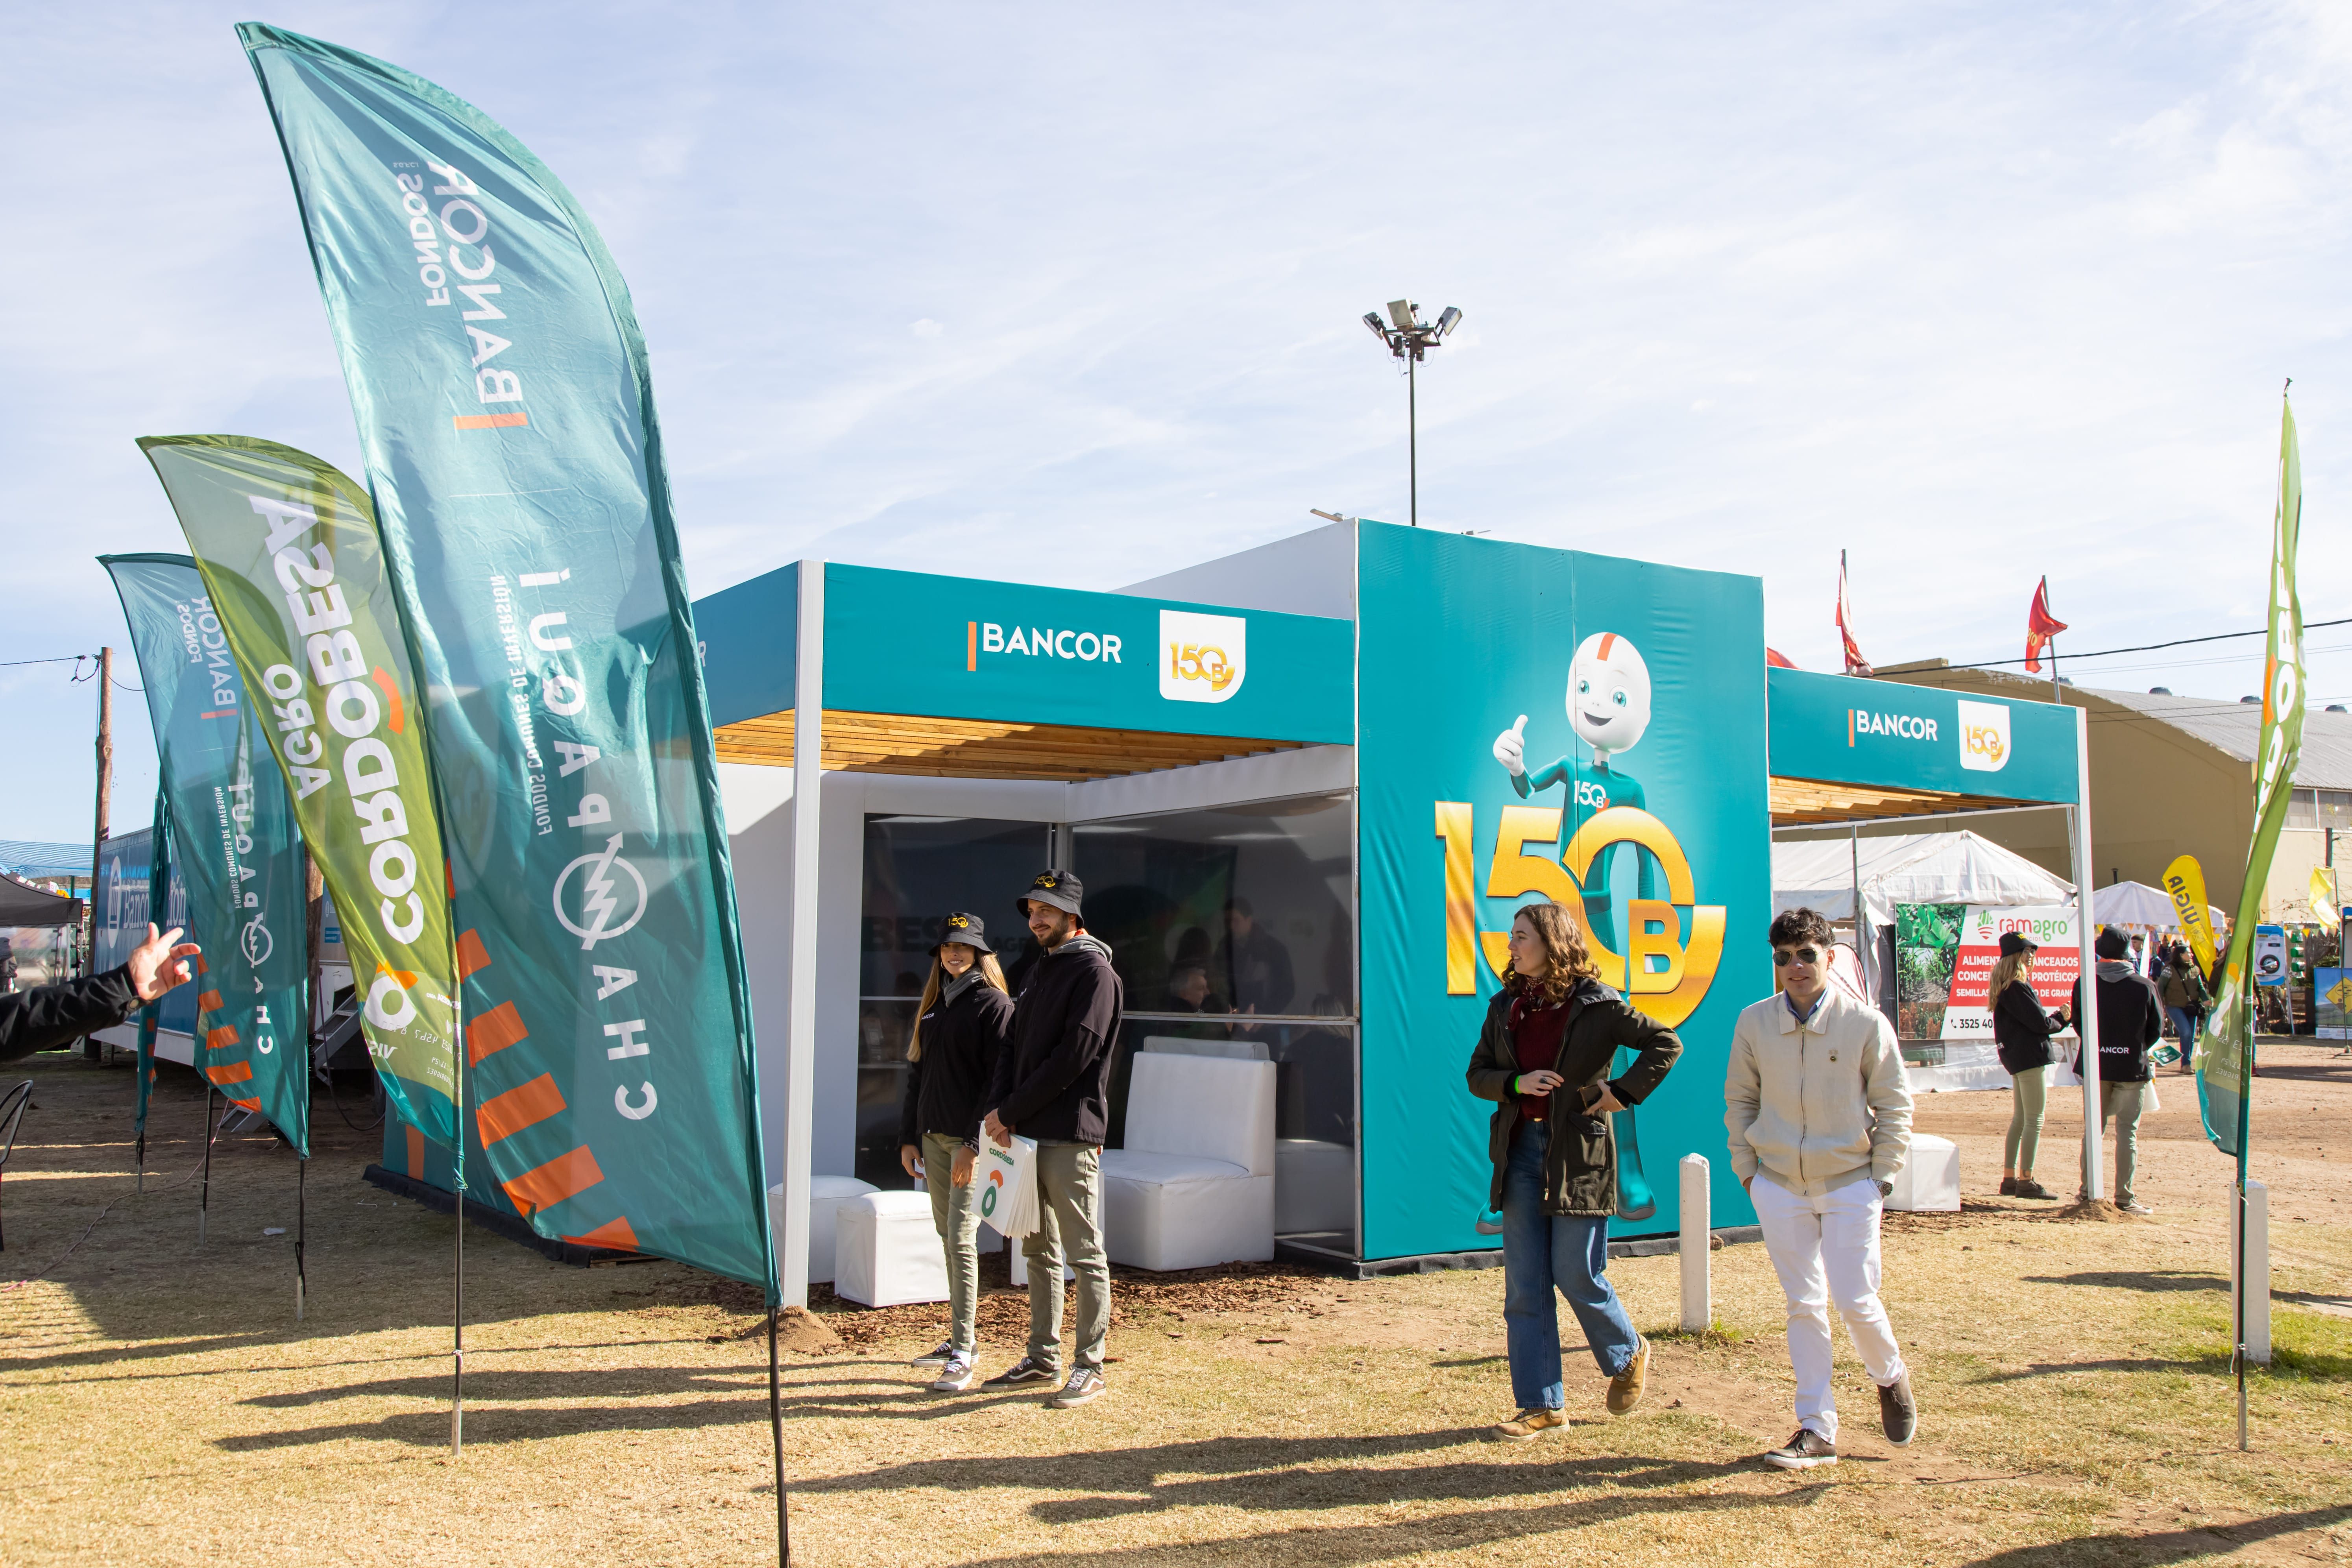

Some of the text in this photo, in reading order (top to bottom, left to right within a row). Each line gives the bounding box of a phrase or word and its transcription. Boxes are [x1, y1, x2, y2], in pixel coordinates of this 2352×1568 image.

[983, 622, 1121, 663] BANCOR
[1857, 710, 1938, 741] BANCOR
[123, 888, 150, 929] Banco
[1999, 918, 2068, 942] ramagro
[1962, 955, 2079, 967] ALIMENT ANCEADOS
[2032, 970, 2079, 982] PROTÉICOS
[1960, 1019, 1979, 1029] 3525
[2098, 1046, 2129, 1054] ANCOR
[989, 1148, 1014, 1167] CORDOBESA
